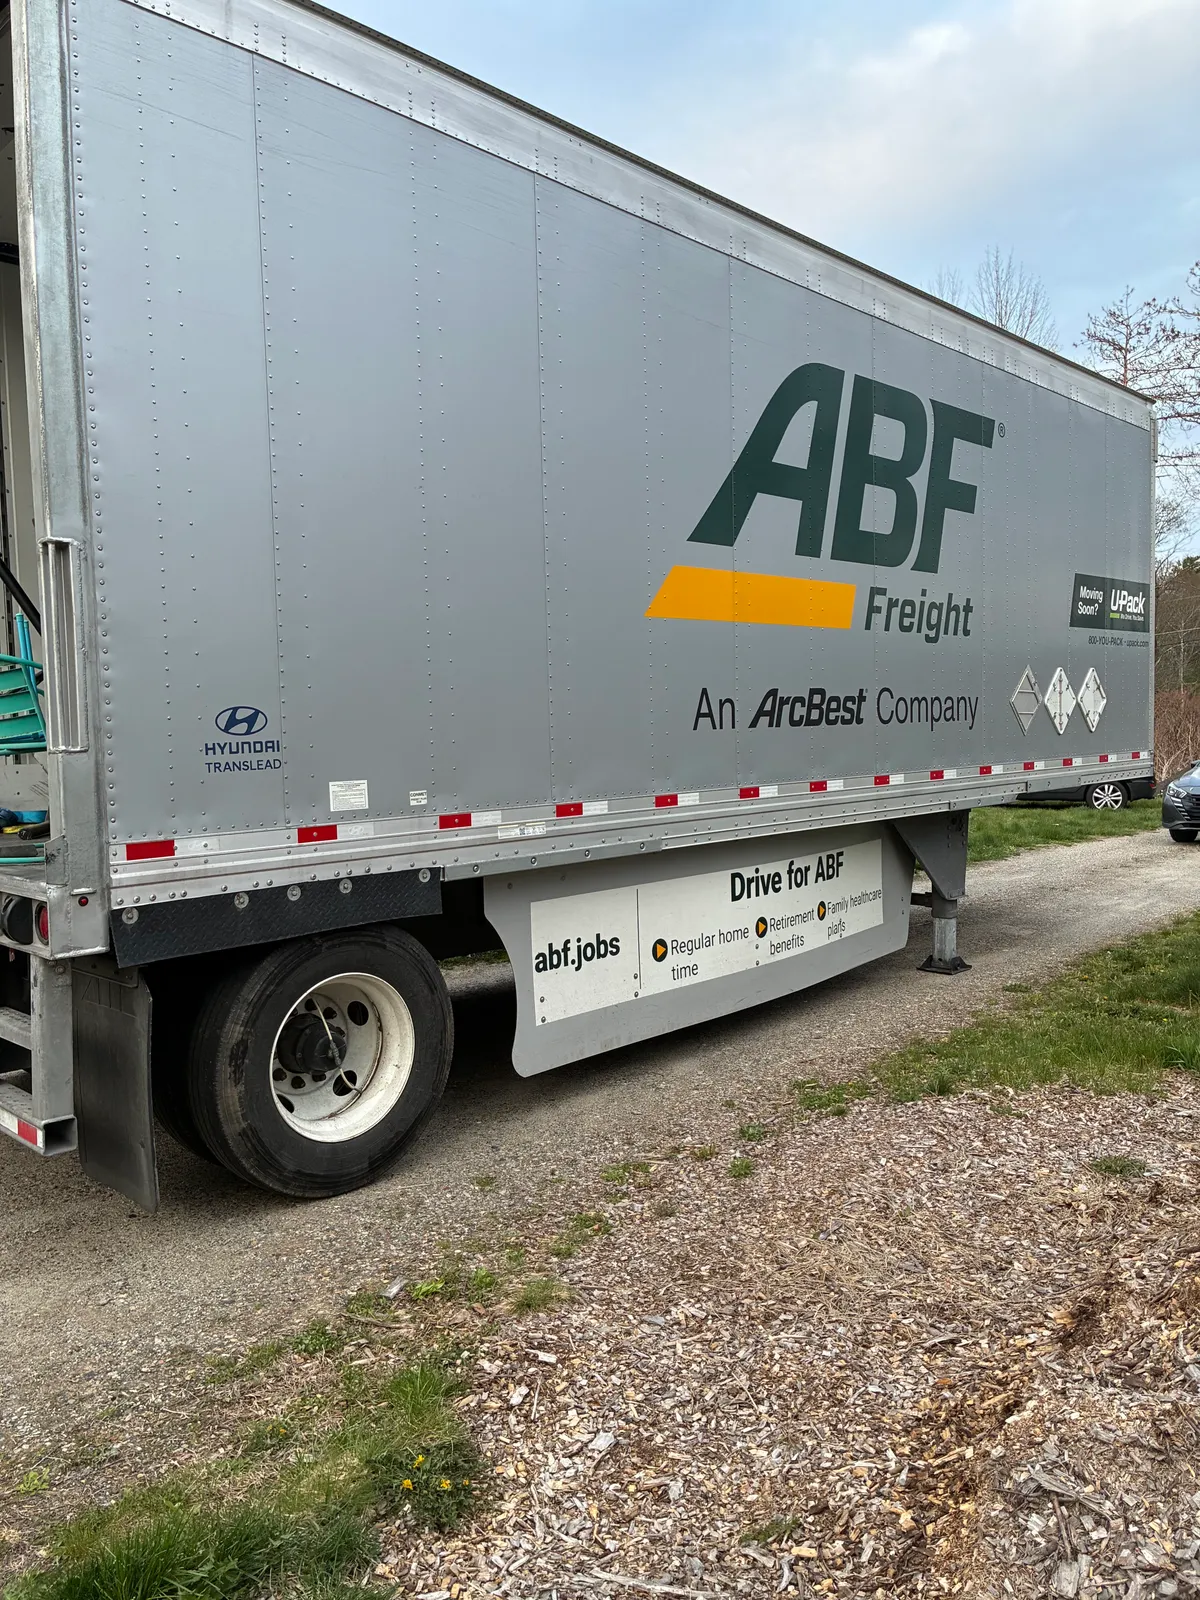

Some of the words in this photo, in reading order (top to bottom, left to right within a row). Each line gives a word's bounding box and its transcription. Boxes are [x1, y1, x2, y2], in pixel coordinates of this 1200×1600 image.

[686, 362, 995, 574] ABF
[1080, 586, 1103, 602] Moving
[864, 586, 974, 644] Freight
[1078, 602, 1098, 615] Soon?
[1088, 636, 1123, 646] 800-YOU-PACK
[1126, 639, 1149, 648] upack.com
[692, 688, 735, 730] An
[748, 687, 867, 729] ArcBest
[876, 686, 979, 731] Company
[204, 740, 280, 756] HYUNDAI
[204, 758, 282, 774] TRANSLEAD
[730, 867, 782, 902] Drive
[787, 860, 810, 890] for
[814, 850, 844, 884] ABF
[827, 896, 850, 916] Family
[849, 888, 882, 908] healthcare
[769, 908, 815, 933] Retirement
[827, 920, 846, 940] plans
[534, 932, 620, 973] abf.jobs
[670, 933, 716, 956] Regular
[718, 927, 750, 945] home
[769, 934, 805, 956] benefits
[671, 962, 699, 981] time
